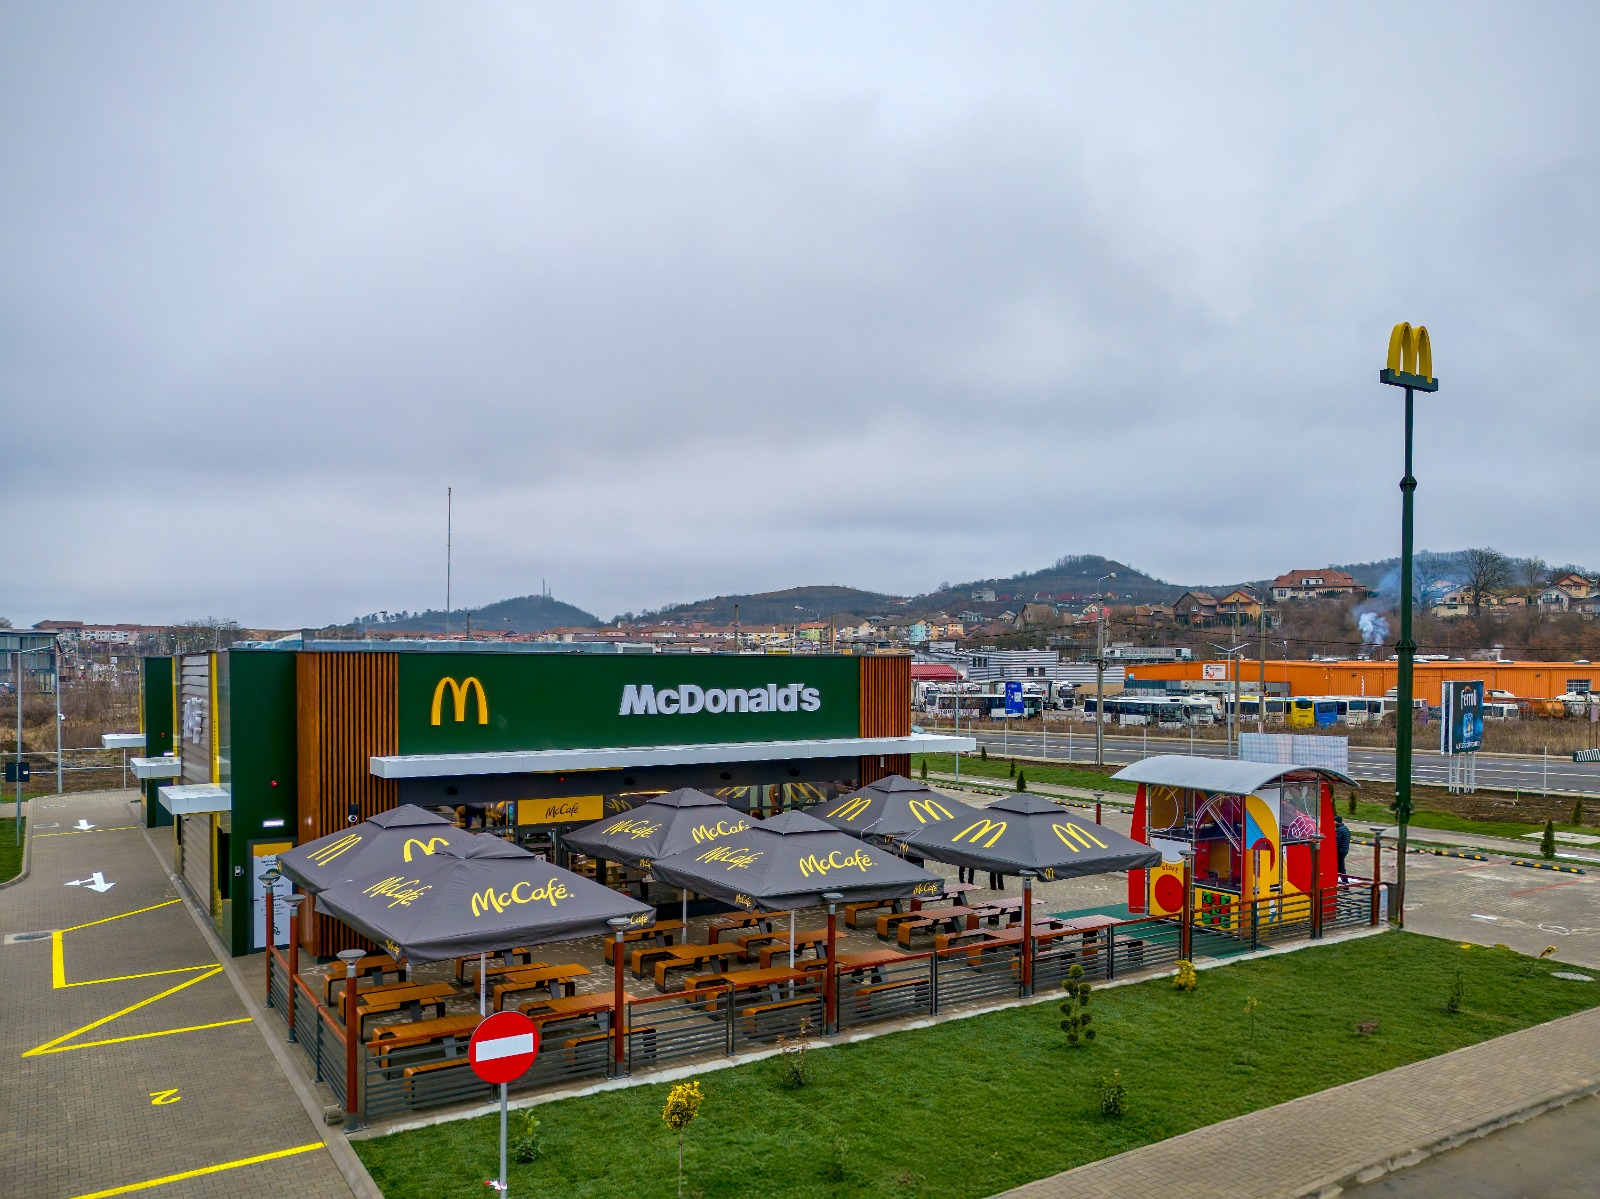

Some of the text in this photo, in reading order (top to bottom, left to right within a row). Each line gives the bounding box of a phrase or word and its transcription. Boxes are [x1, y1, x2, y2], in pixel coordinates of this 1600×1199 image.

[618, 683, 822, 716] McDonald's
[545, 802, 579, 819] McCafé
[602, 819, 663, 840] McCafé
[695, 846, 764, 871] McCafé
[799, 848, 873, 878] McCafé
[362, 876, 433, 909] McCafé
[471, 877, 569, 917] McCafé
[913, 882, 939, 895] McCafé
[149, 1088, 181, 1105] 2
